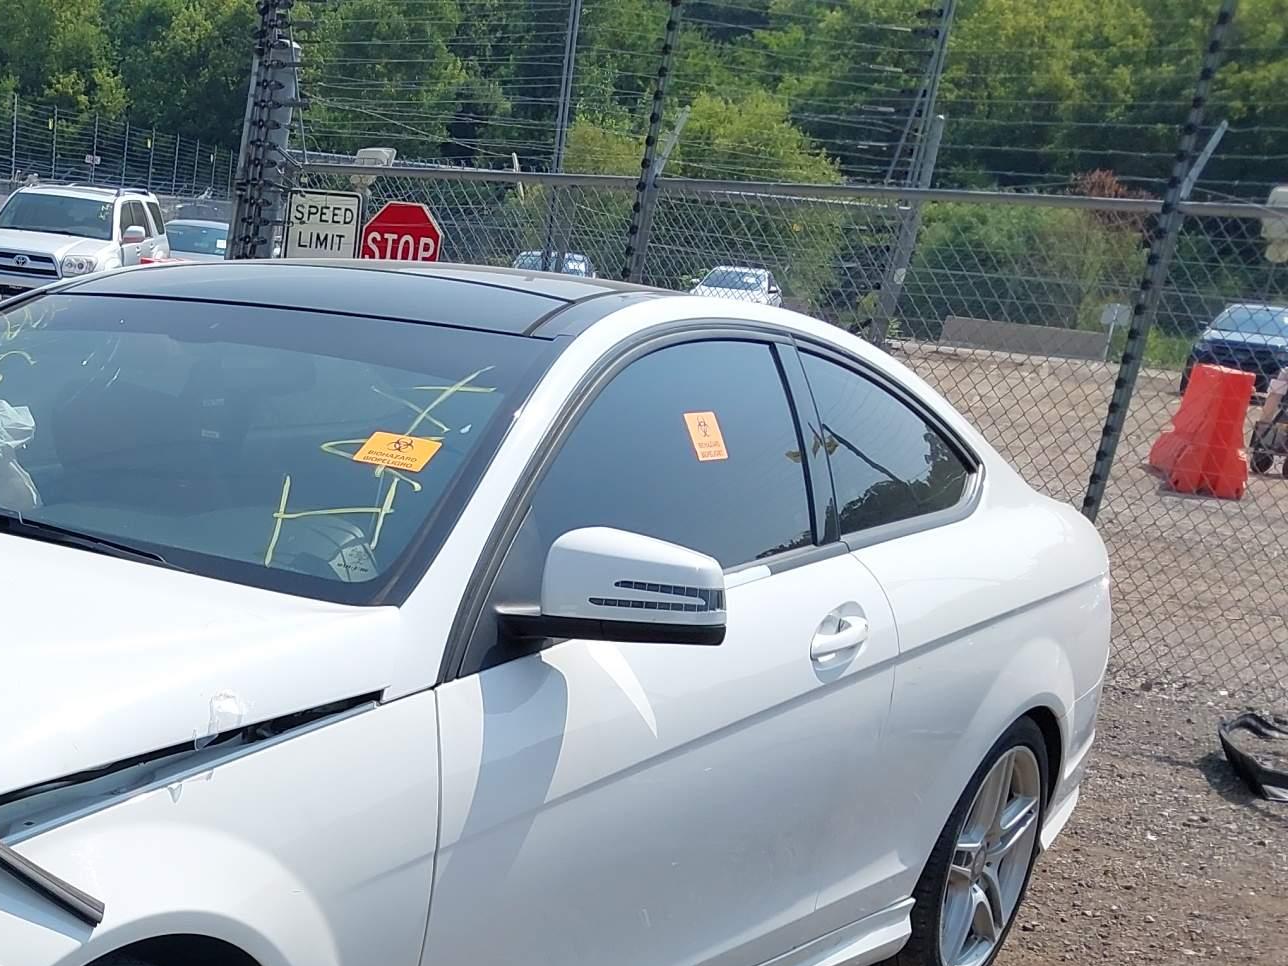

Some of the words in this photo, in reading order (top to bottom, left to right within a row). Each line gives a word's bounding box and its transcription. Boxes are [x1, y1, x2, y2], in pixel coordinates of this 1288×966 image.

[294, 204, 354, 225] SPEED
[297, 231, 345, 251] LIMIT
[365, 232, 434, 261] STOP
[368, 449, 417, 463] BIOHAZARD
